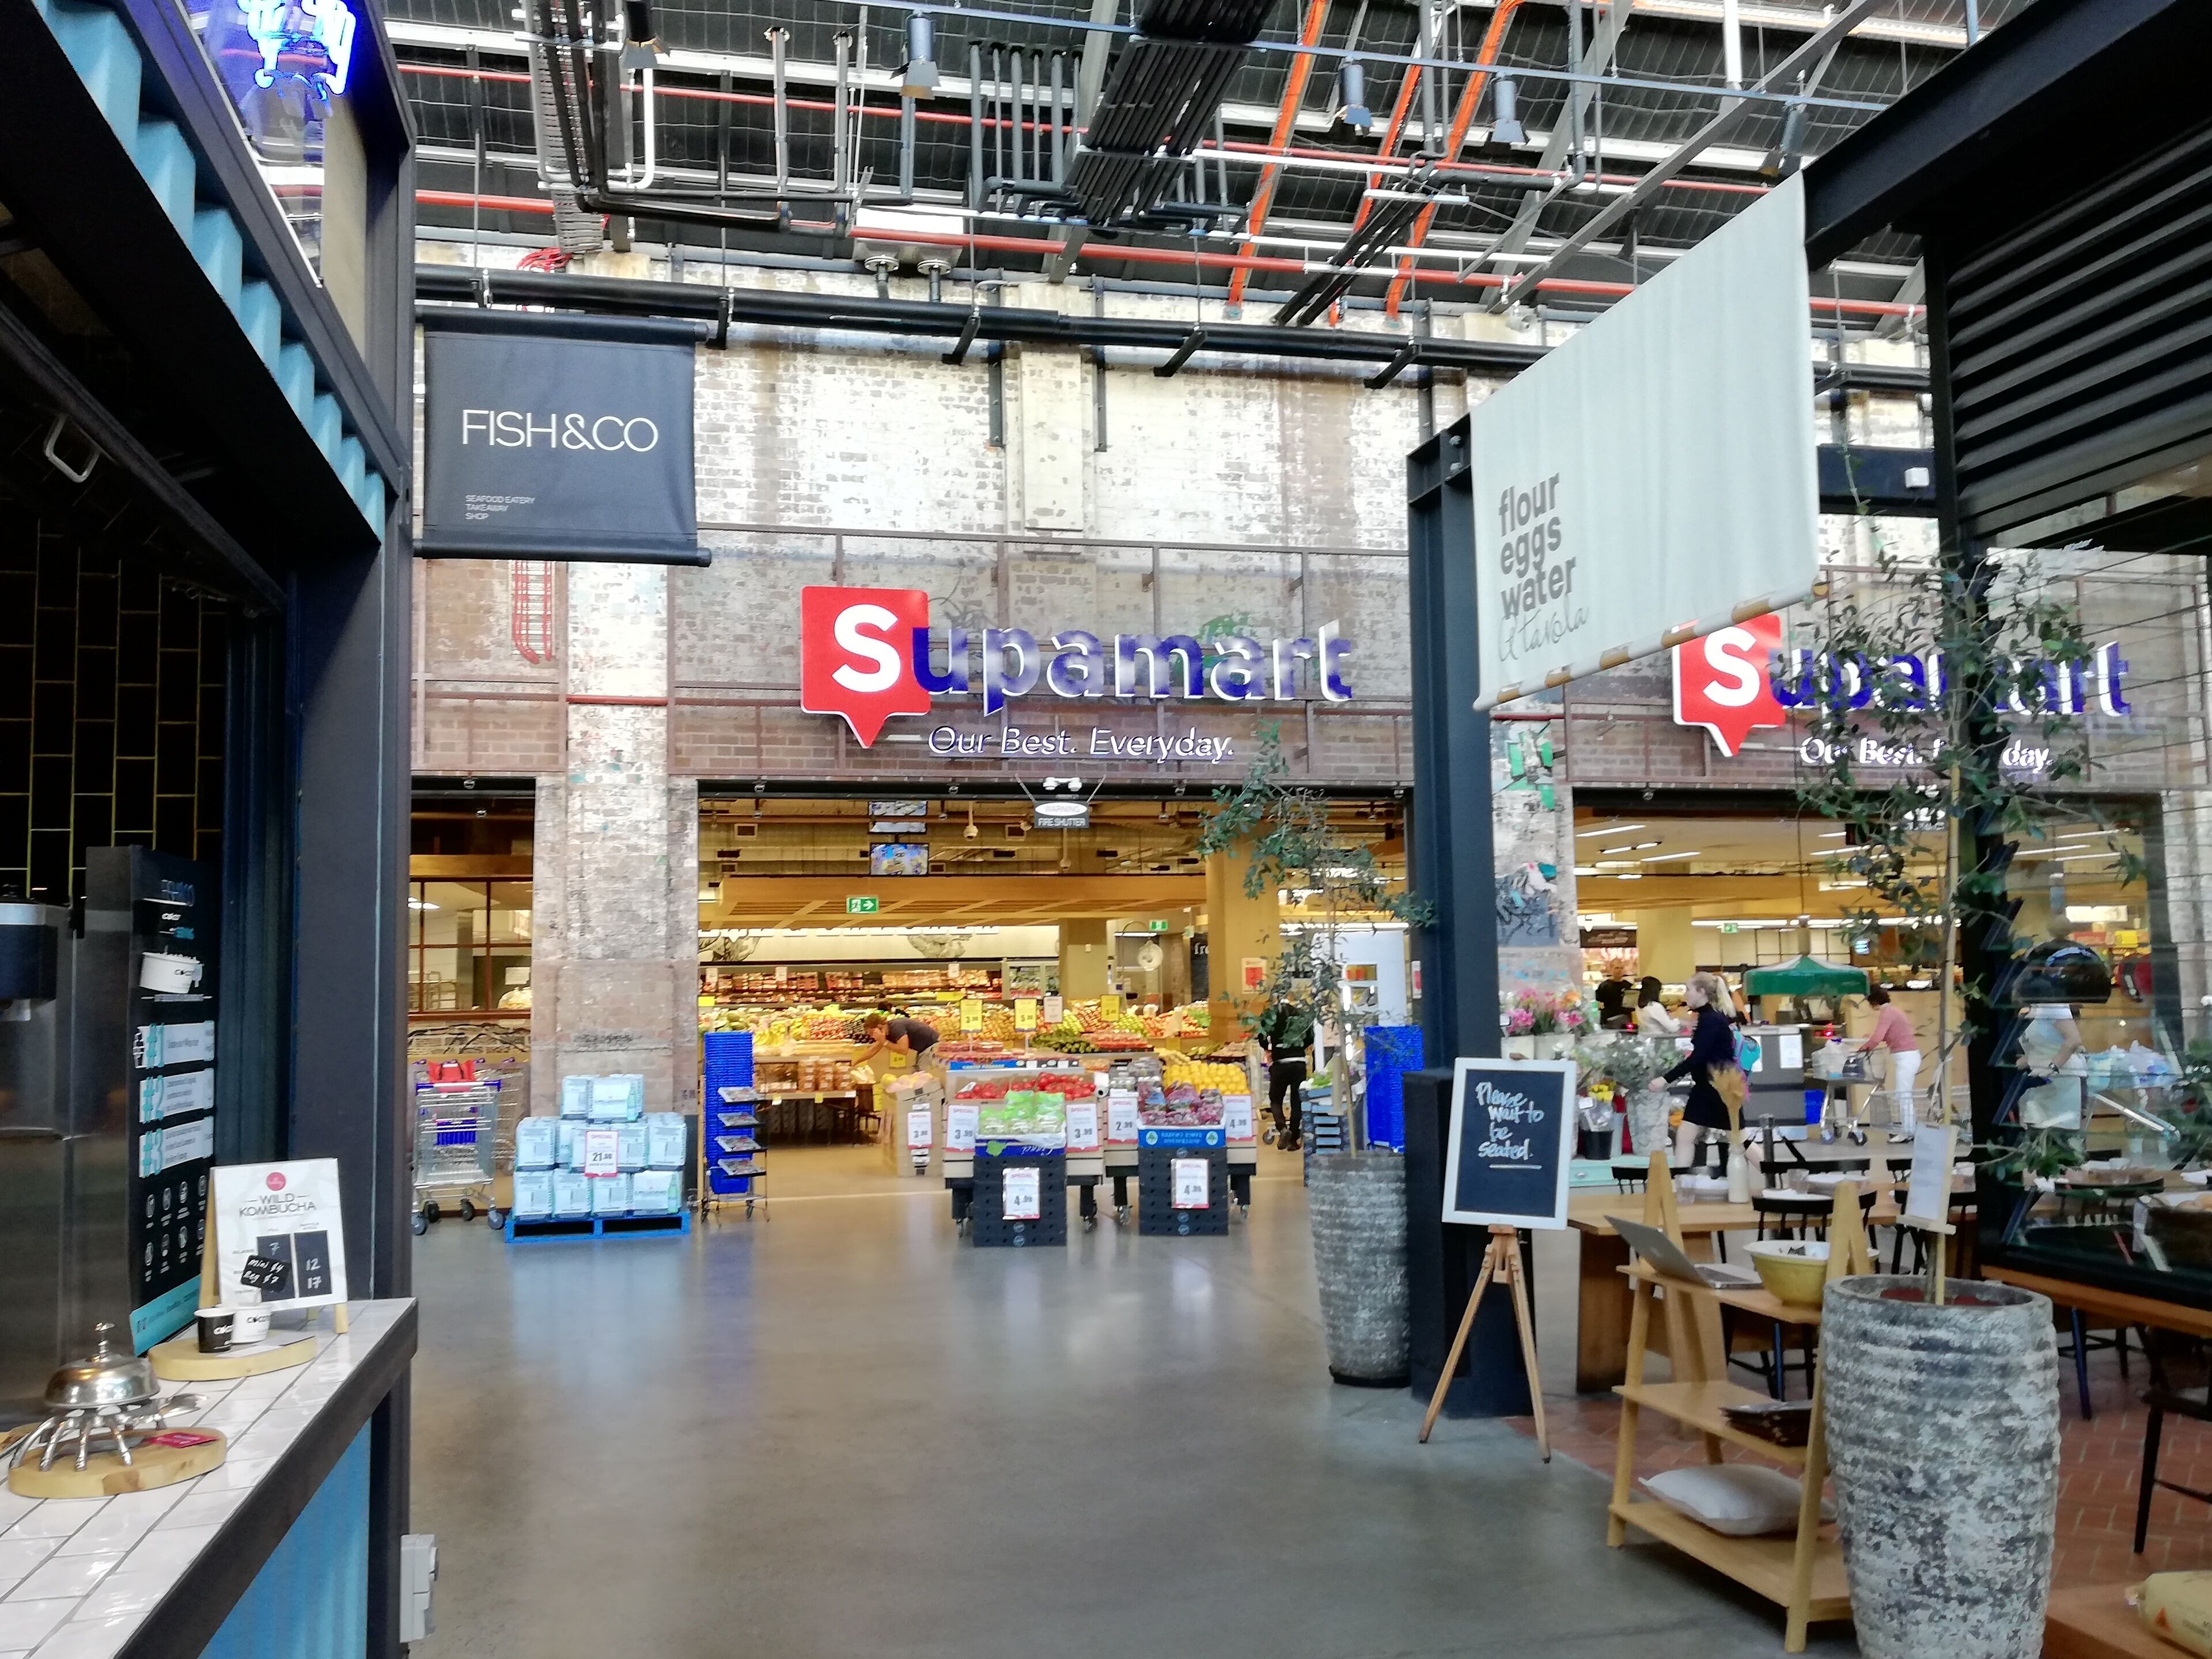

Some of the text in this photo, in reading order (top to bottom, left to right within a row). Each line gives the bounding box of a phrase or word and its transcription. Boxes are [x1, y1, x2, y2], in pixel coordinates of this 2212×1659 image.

[462, 409, 659, 452] FISH&CO
[465, 495, 504, 503] SEAFOOD
[1498, 472, 1560, 537] flour
[1500, 516, 1562, 578] eggs
[1500, 556, 1577, 620] water
[831, 603, 1353, 717] Supamart
[928, 725, 1234, 764] Our Best. Everyday.
[1475, 1082, 1528, 1107] Please
[1527, 1101, 1544, 1123] to
[1489, 1122, 1513, 1142] be
[239, 1201, 317, 1217] KOMBUCHA
[259, 1192, 295, 1205] WILD
[269, 1242, 280, 1256] 7
[306, 1257, 321, 1271] 12
[307, 1276, 322, 1289] 17
